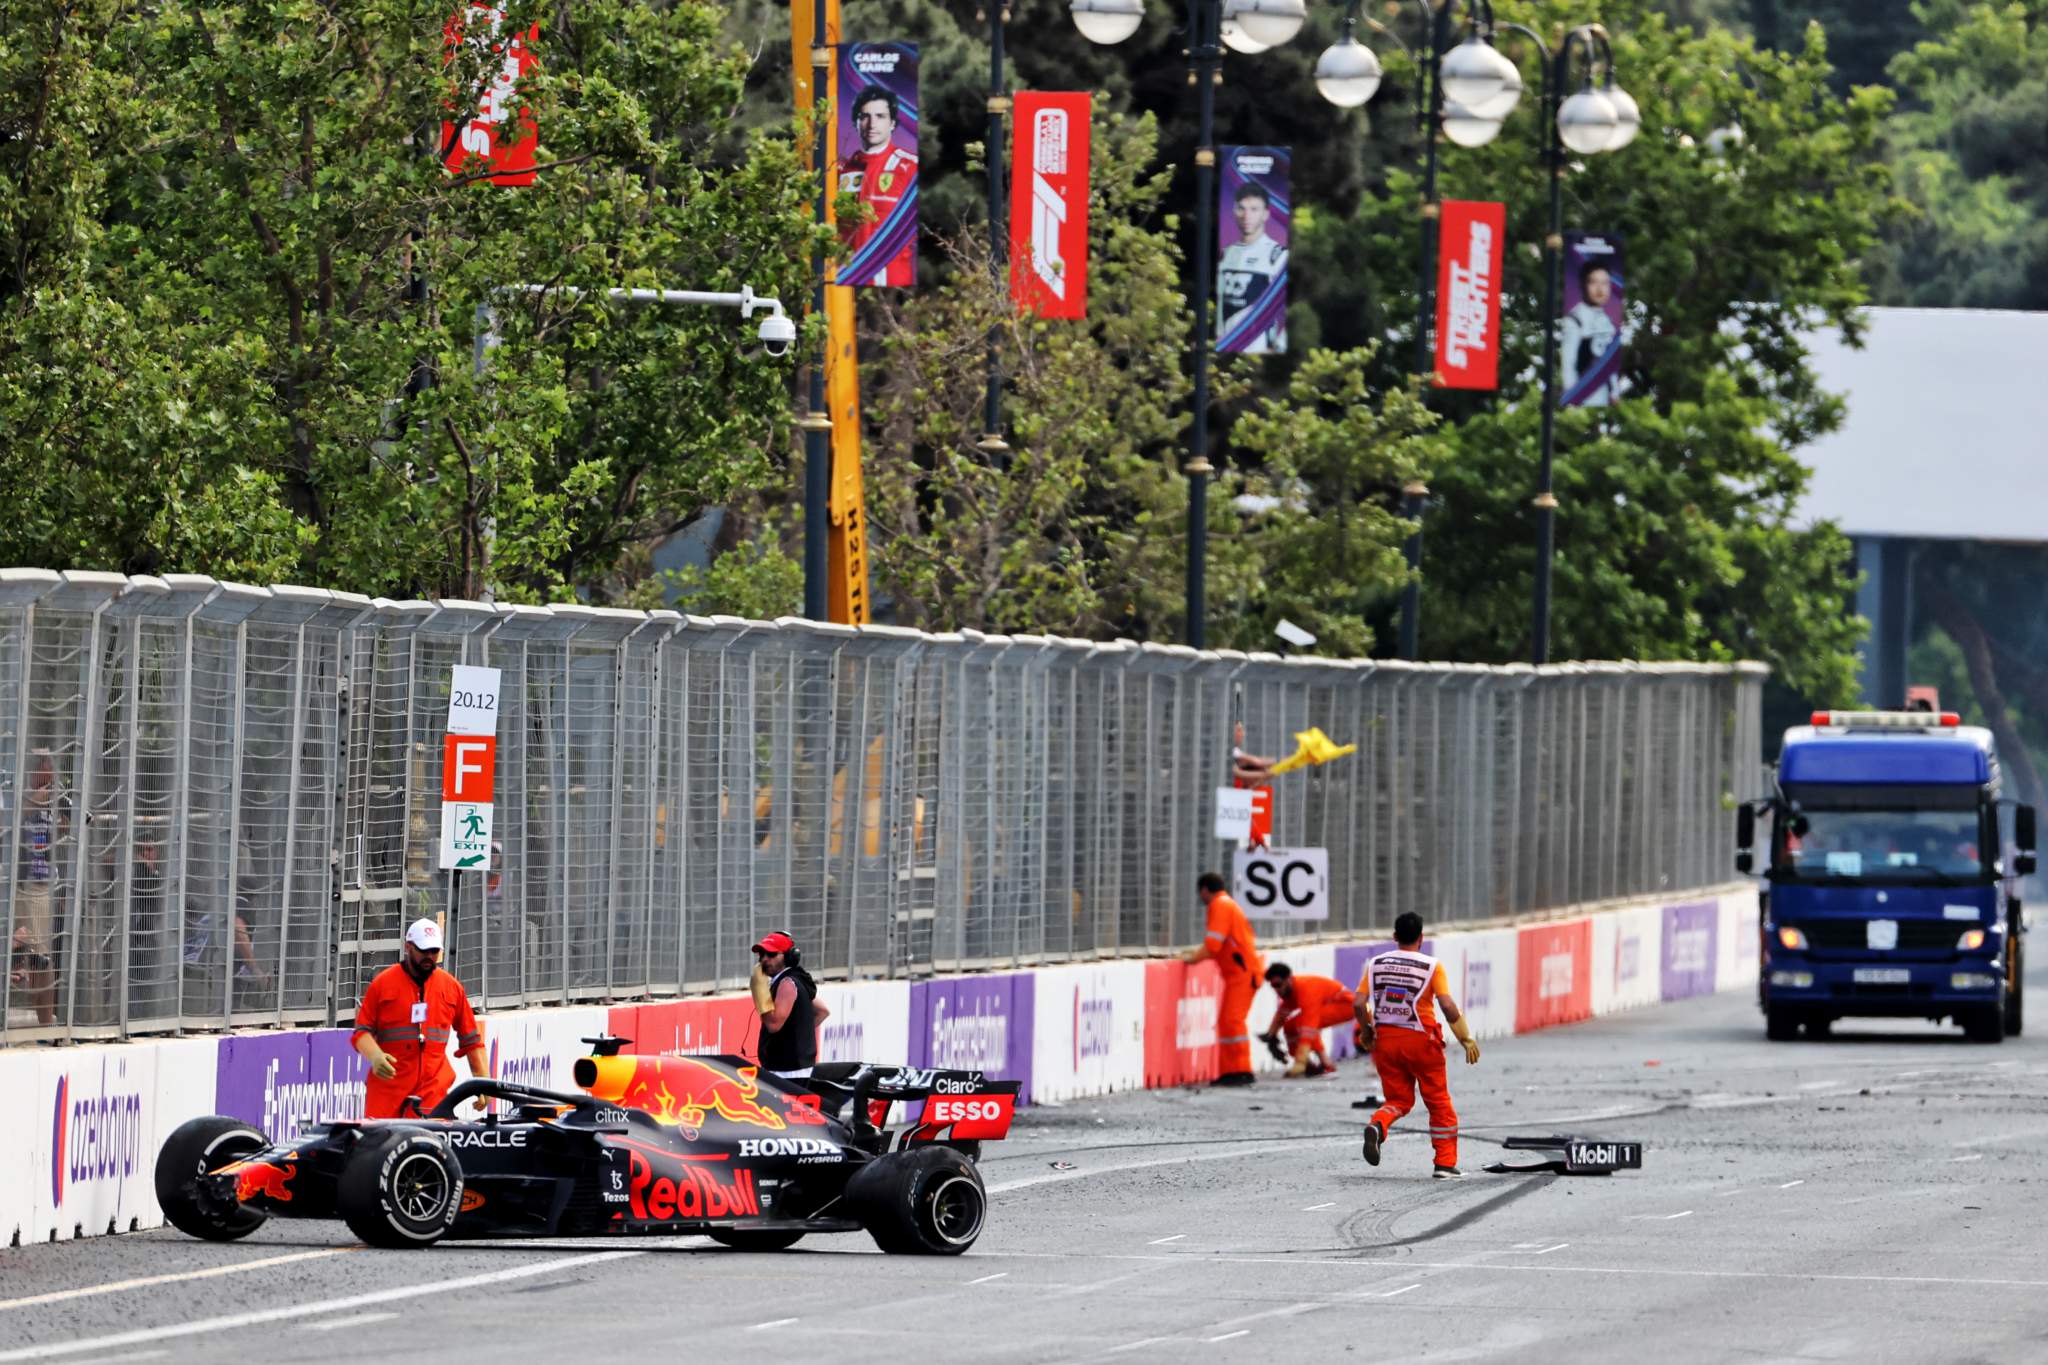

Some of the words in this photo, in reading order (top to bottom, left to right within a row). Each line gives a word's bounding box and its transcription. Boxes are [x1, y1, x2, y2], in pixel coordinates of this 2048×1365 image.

[453, 690, 495, 710] 20.12
[454, 742, 488, 795] F
[454, 842, 487, 851] EXIT
[1245, 860, 1315, 907] SC
[936, 1078, 976, 1094] Claro
[595, 1107, 630, 1124] citrix
[934, 1101, 1001, 1121] ESSO
[738, 1137, 842, 1157] HONDA
[1571, 1144, 1617, 1165] Mobil
[1623, 1146, 1631, 1163] 1
[380, 1140, 409, 1193] ZERO
[797, 1155, 842, 1165] HYBRID
[602, 1191, 630, 1203] Tezos
